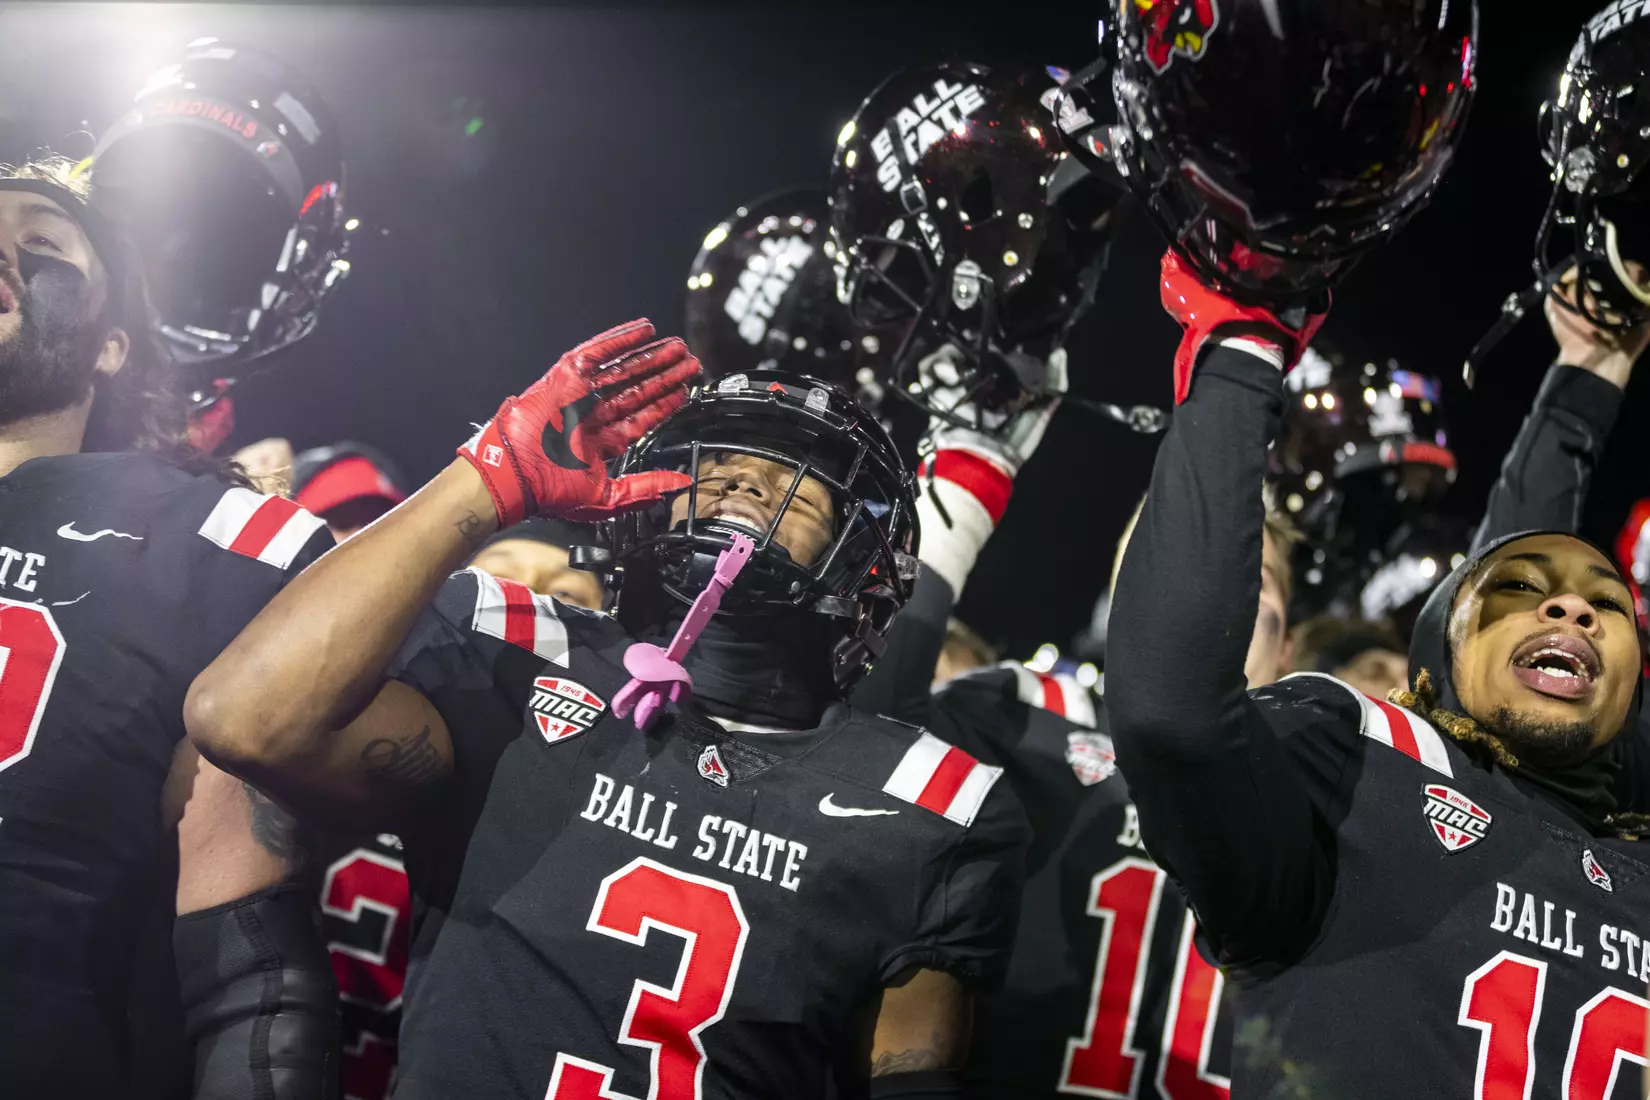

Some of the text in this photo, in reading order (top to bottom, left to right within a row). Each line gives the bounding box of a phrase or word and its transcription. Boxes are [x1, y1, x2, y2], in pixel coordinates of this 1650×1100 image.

[877, 84, 986, 192] STATE
[529, 690, 599, 727] MAC
[580, 773, 808, 892] BALL STATE
[1424, 797, 1488, 838] MAC
[1490, 882, 1584, 959] BALL
[545, 856, 750, 1100] 3
